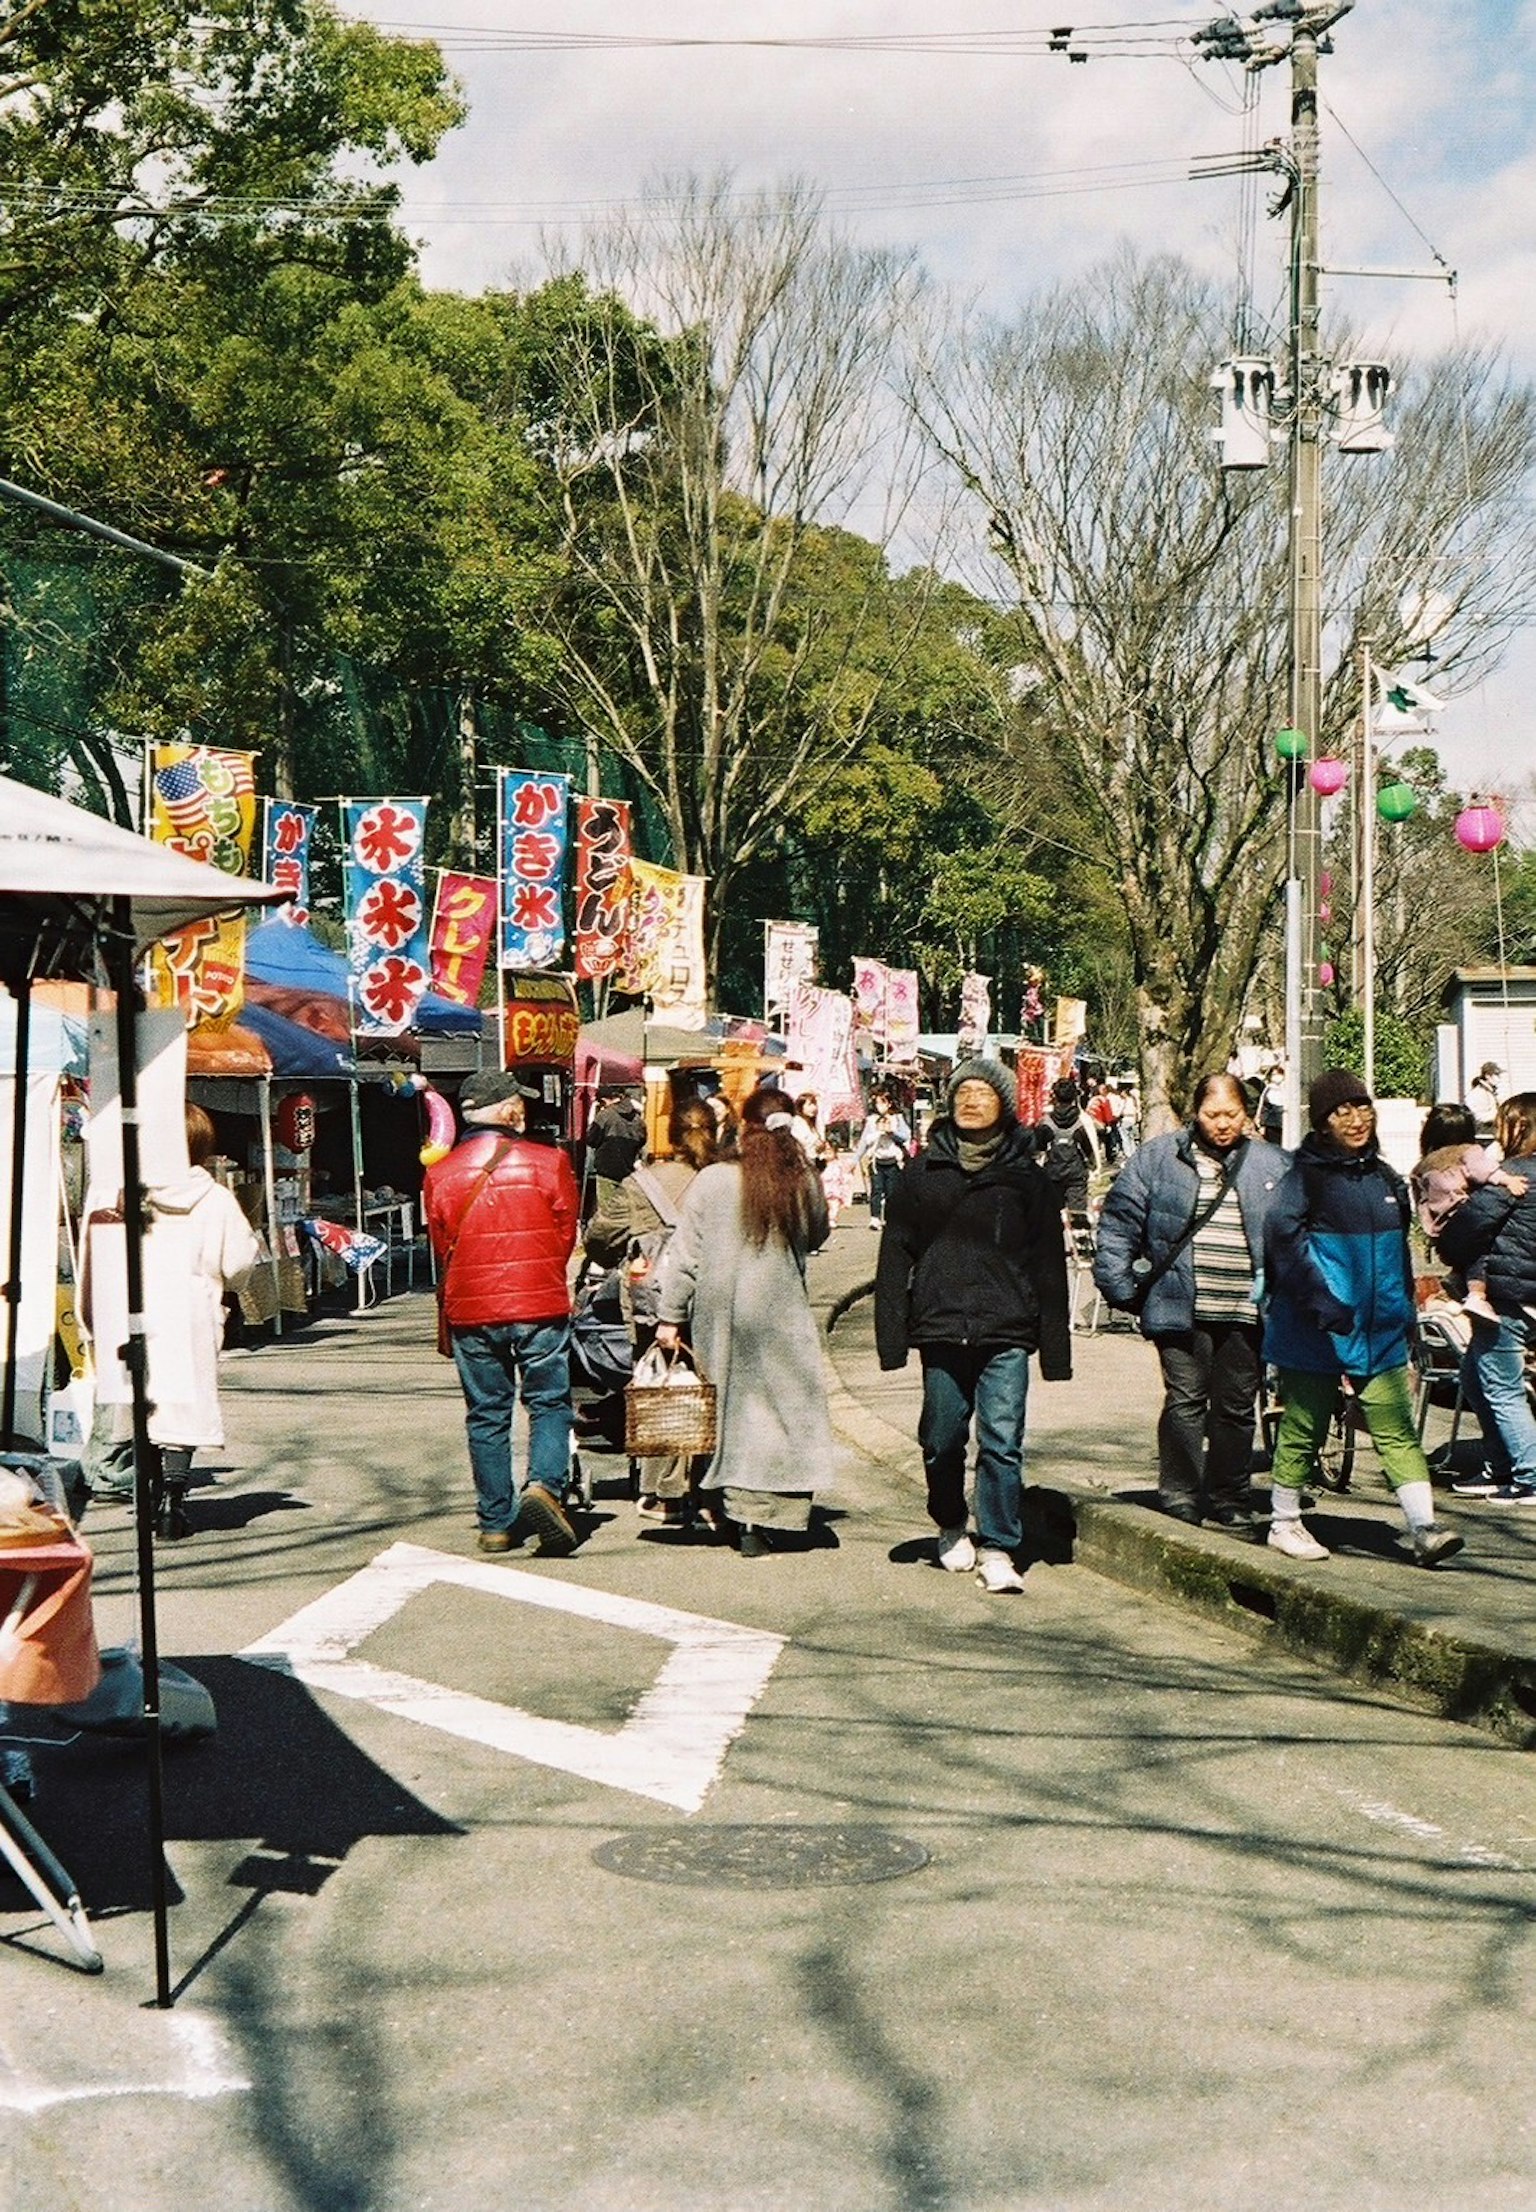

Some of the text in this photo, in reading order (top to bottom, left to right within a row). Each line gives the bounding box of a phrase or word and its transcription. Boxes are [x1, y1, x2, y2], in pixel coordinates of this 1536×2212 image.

[512, 782, 560, 930] かき氷
[580, 806, 628, 937] うどん
